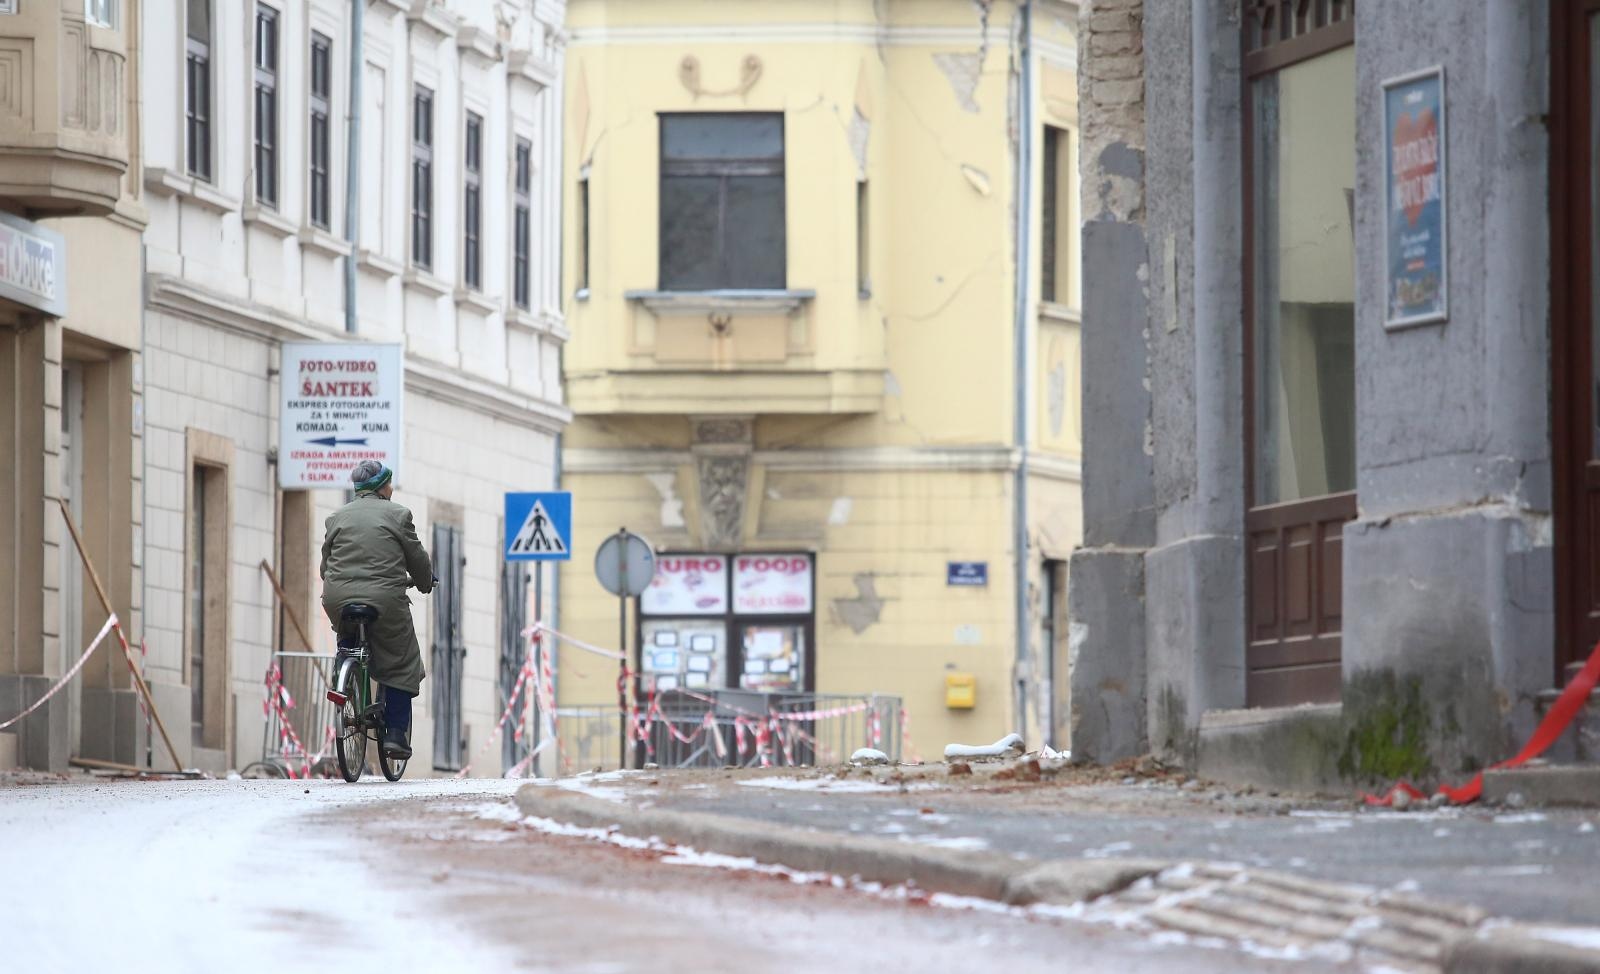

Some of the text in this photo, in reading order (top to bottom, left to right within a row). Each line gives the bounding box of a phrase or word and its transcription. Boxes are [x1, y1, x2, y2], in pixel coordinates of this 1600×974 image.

[299, 361, 377, 372] FOTO-VIDEO
[302, 378, 374, 397] ŠANTEK
[287, 401, 391, 409] EKSPRES FOTOGRAFIJE
[310, 411, 322, 419] ZA
[296, 422, 338, 432] KOMADA
[361, 422, 389, 432] KUNA
[290, 451, 387, 459] IZRADA AMATERSKIH
[307, 472, 335, 481] SLIKA
[656, 558, 807, 573] URO FOOD
